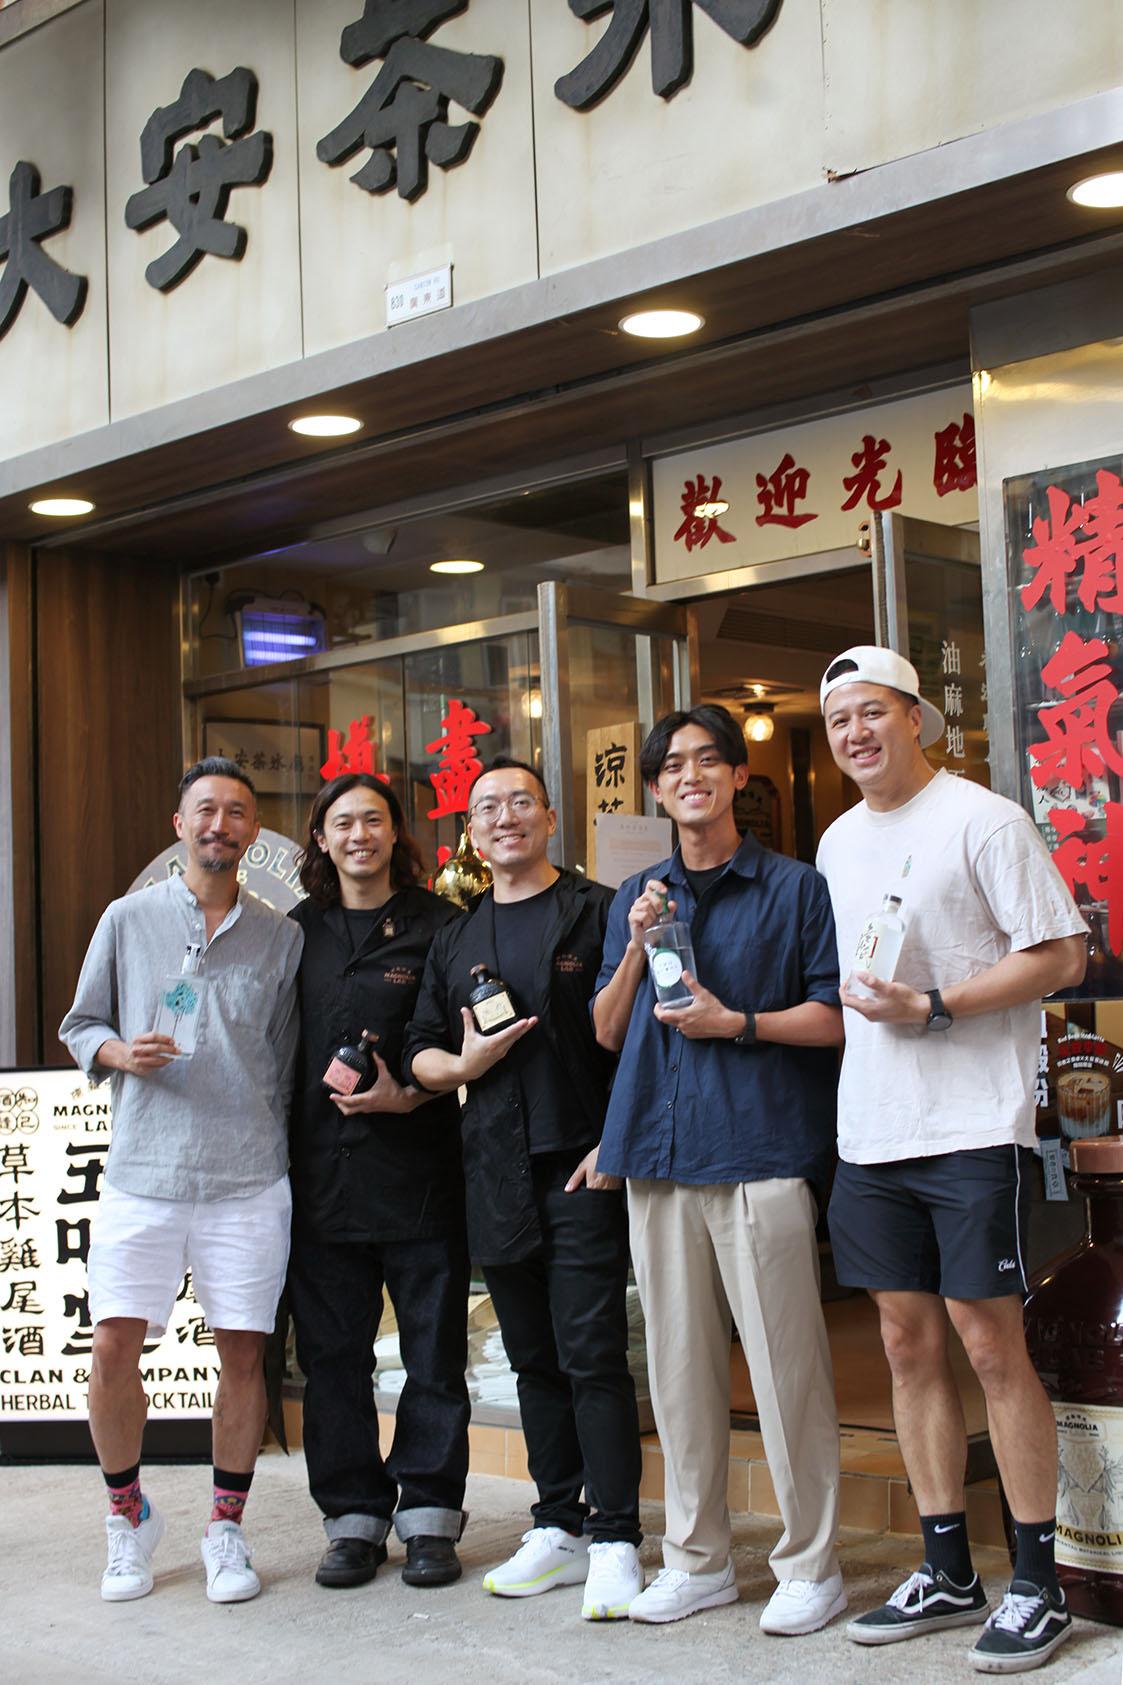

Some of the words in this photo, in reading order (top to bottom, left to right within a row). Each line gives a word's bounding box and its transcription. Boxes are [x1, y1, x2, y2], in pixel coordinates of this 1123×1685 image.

[941, 639, 966, 778] 油麻地
[53, 1104, 112, 1117] MAGN
[85, 1120, 112, 1132] LA
[0, 1369, 63, 1384] CLAN
[1, 1393, 77, 1411] HERBAL
